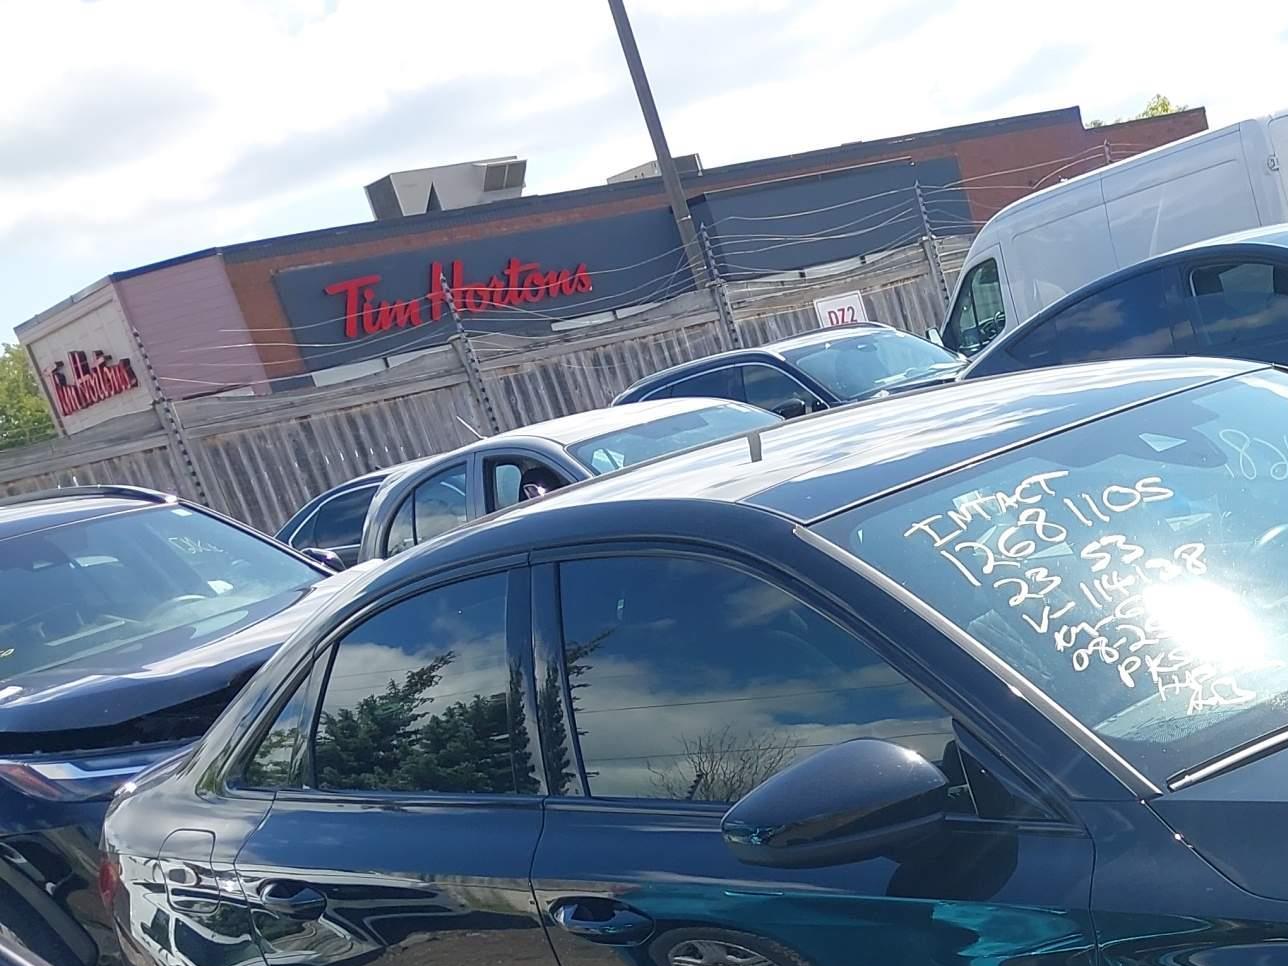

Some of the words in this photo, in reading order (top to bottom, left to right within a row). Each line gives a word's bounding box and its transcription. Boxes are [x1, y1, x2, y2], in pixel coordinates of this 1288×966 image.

[324, 274, 422, 337] Tim
[426, 257, 592, 320] Hortons
[827, 305, 858, 326] DZ2
[993, 566, 1062, 607] 23
